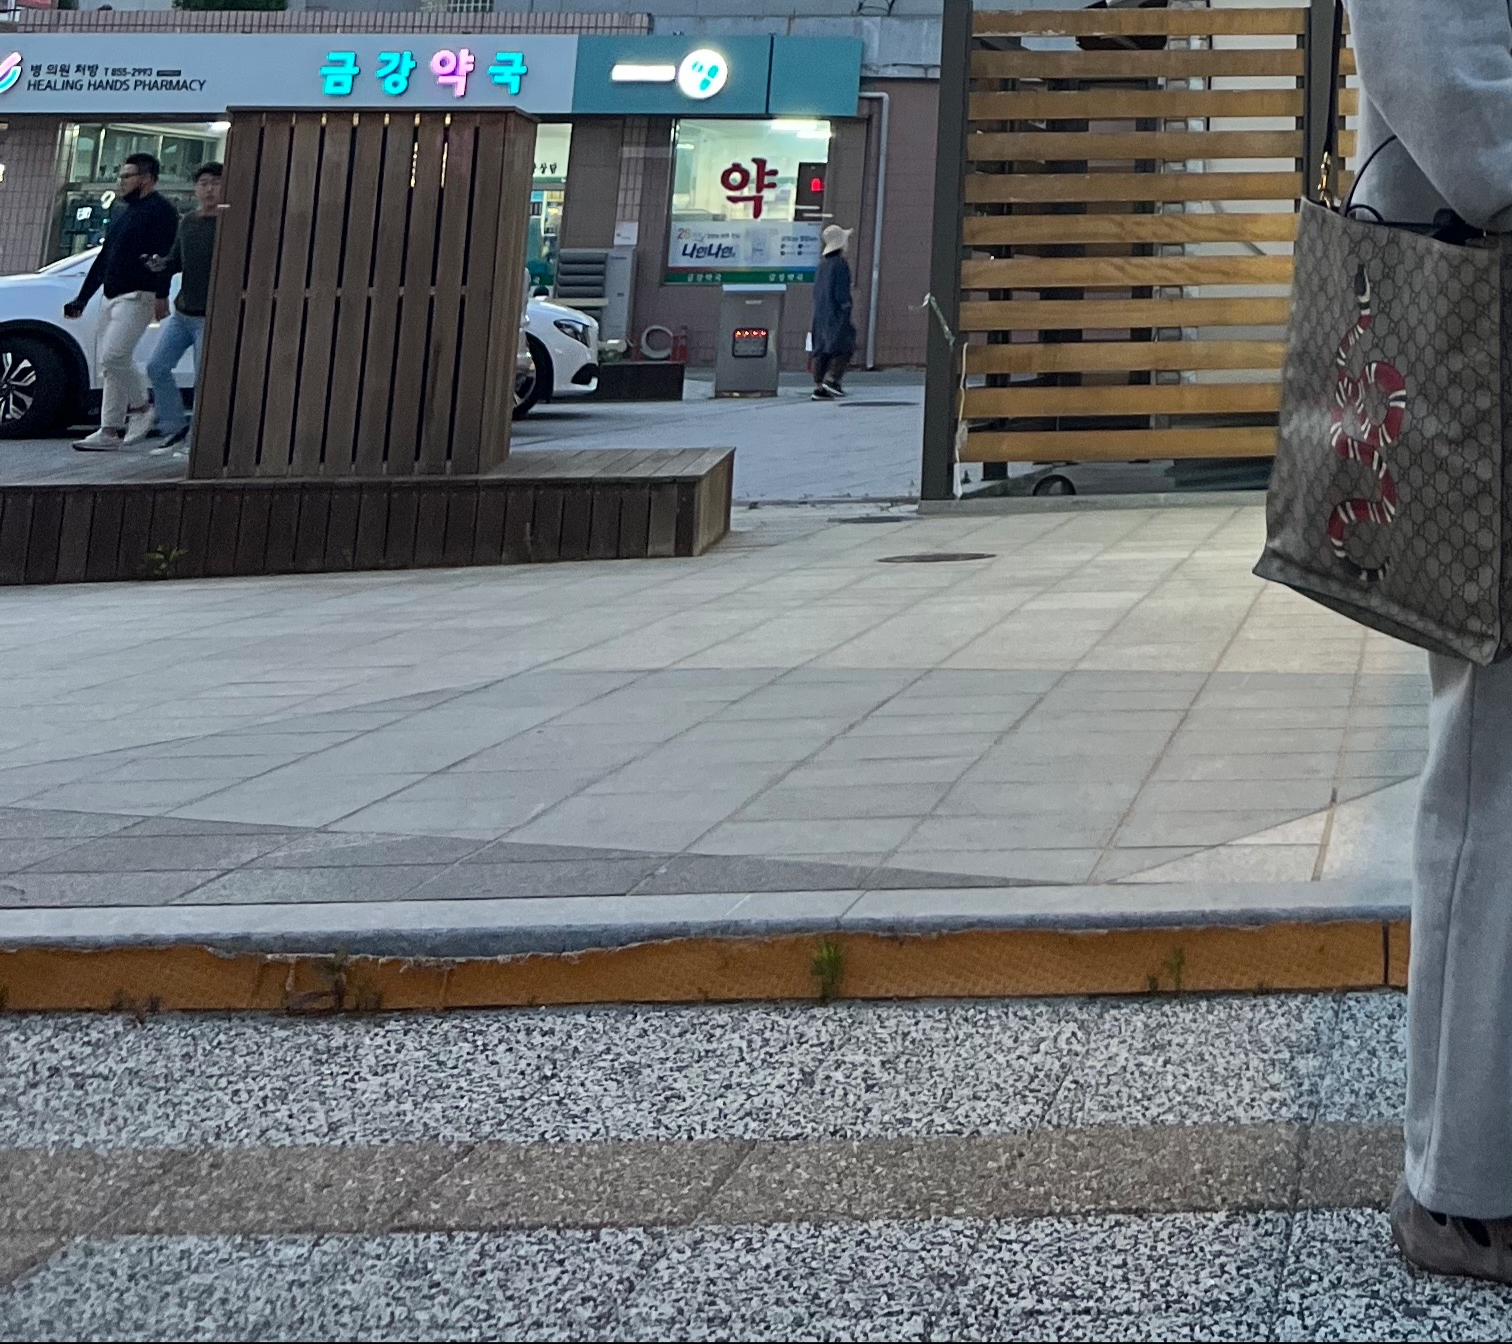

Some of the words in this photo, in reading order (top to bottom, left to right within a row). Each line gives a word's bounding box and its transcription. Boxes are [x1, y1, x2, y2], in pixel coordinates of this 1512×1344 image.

[27, 79, 84, 92] HEALING
[87, 79, 130, 92] HANDS
[133, 79, 207, 92] PHARMACY
[319, 48, 528, 97] 금강약국
[721, 157, 779, 219] 약
